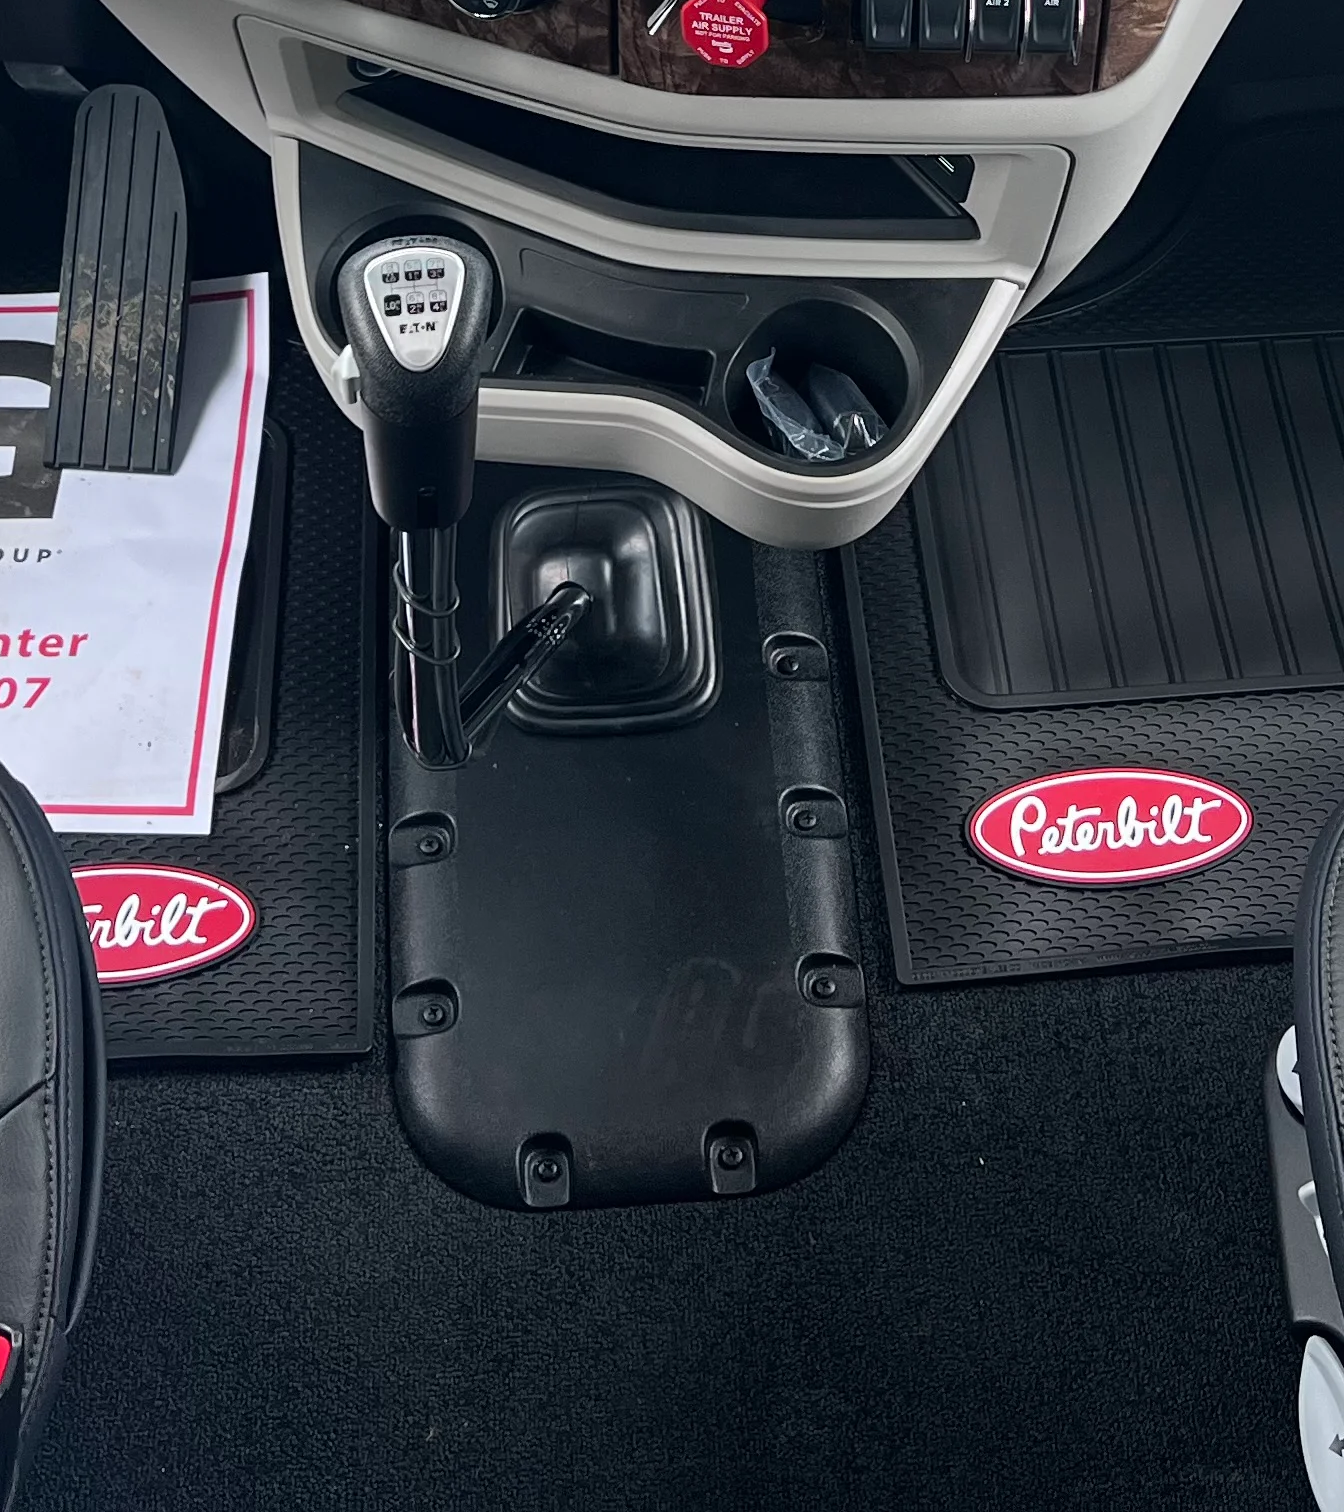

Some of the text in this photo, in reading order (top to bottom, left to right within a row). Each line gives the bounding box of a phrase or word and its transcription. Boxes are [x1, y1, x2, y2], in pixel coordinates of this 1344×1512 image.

[1044, 0, 1060, 7] AIR
[699, 11, 744, 25] TRAILER
[691, 20, 753, 36] AIR SUPPLY
[722, 33, 751, 42] PARKING
[1009, 795, 1223, 857] Peterbilt
[83, 892, 228, 948] rbilt
